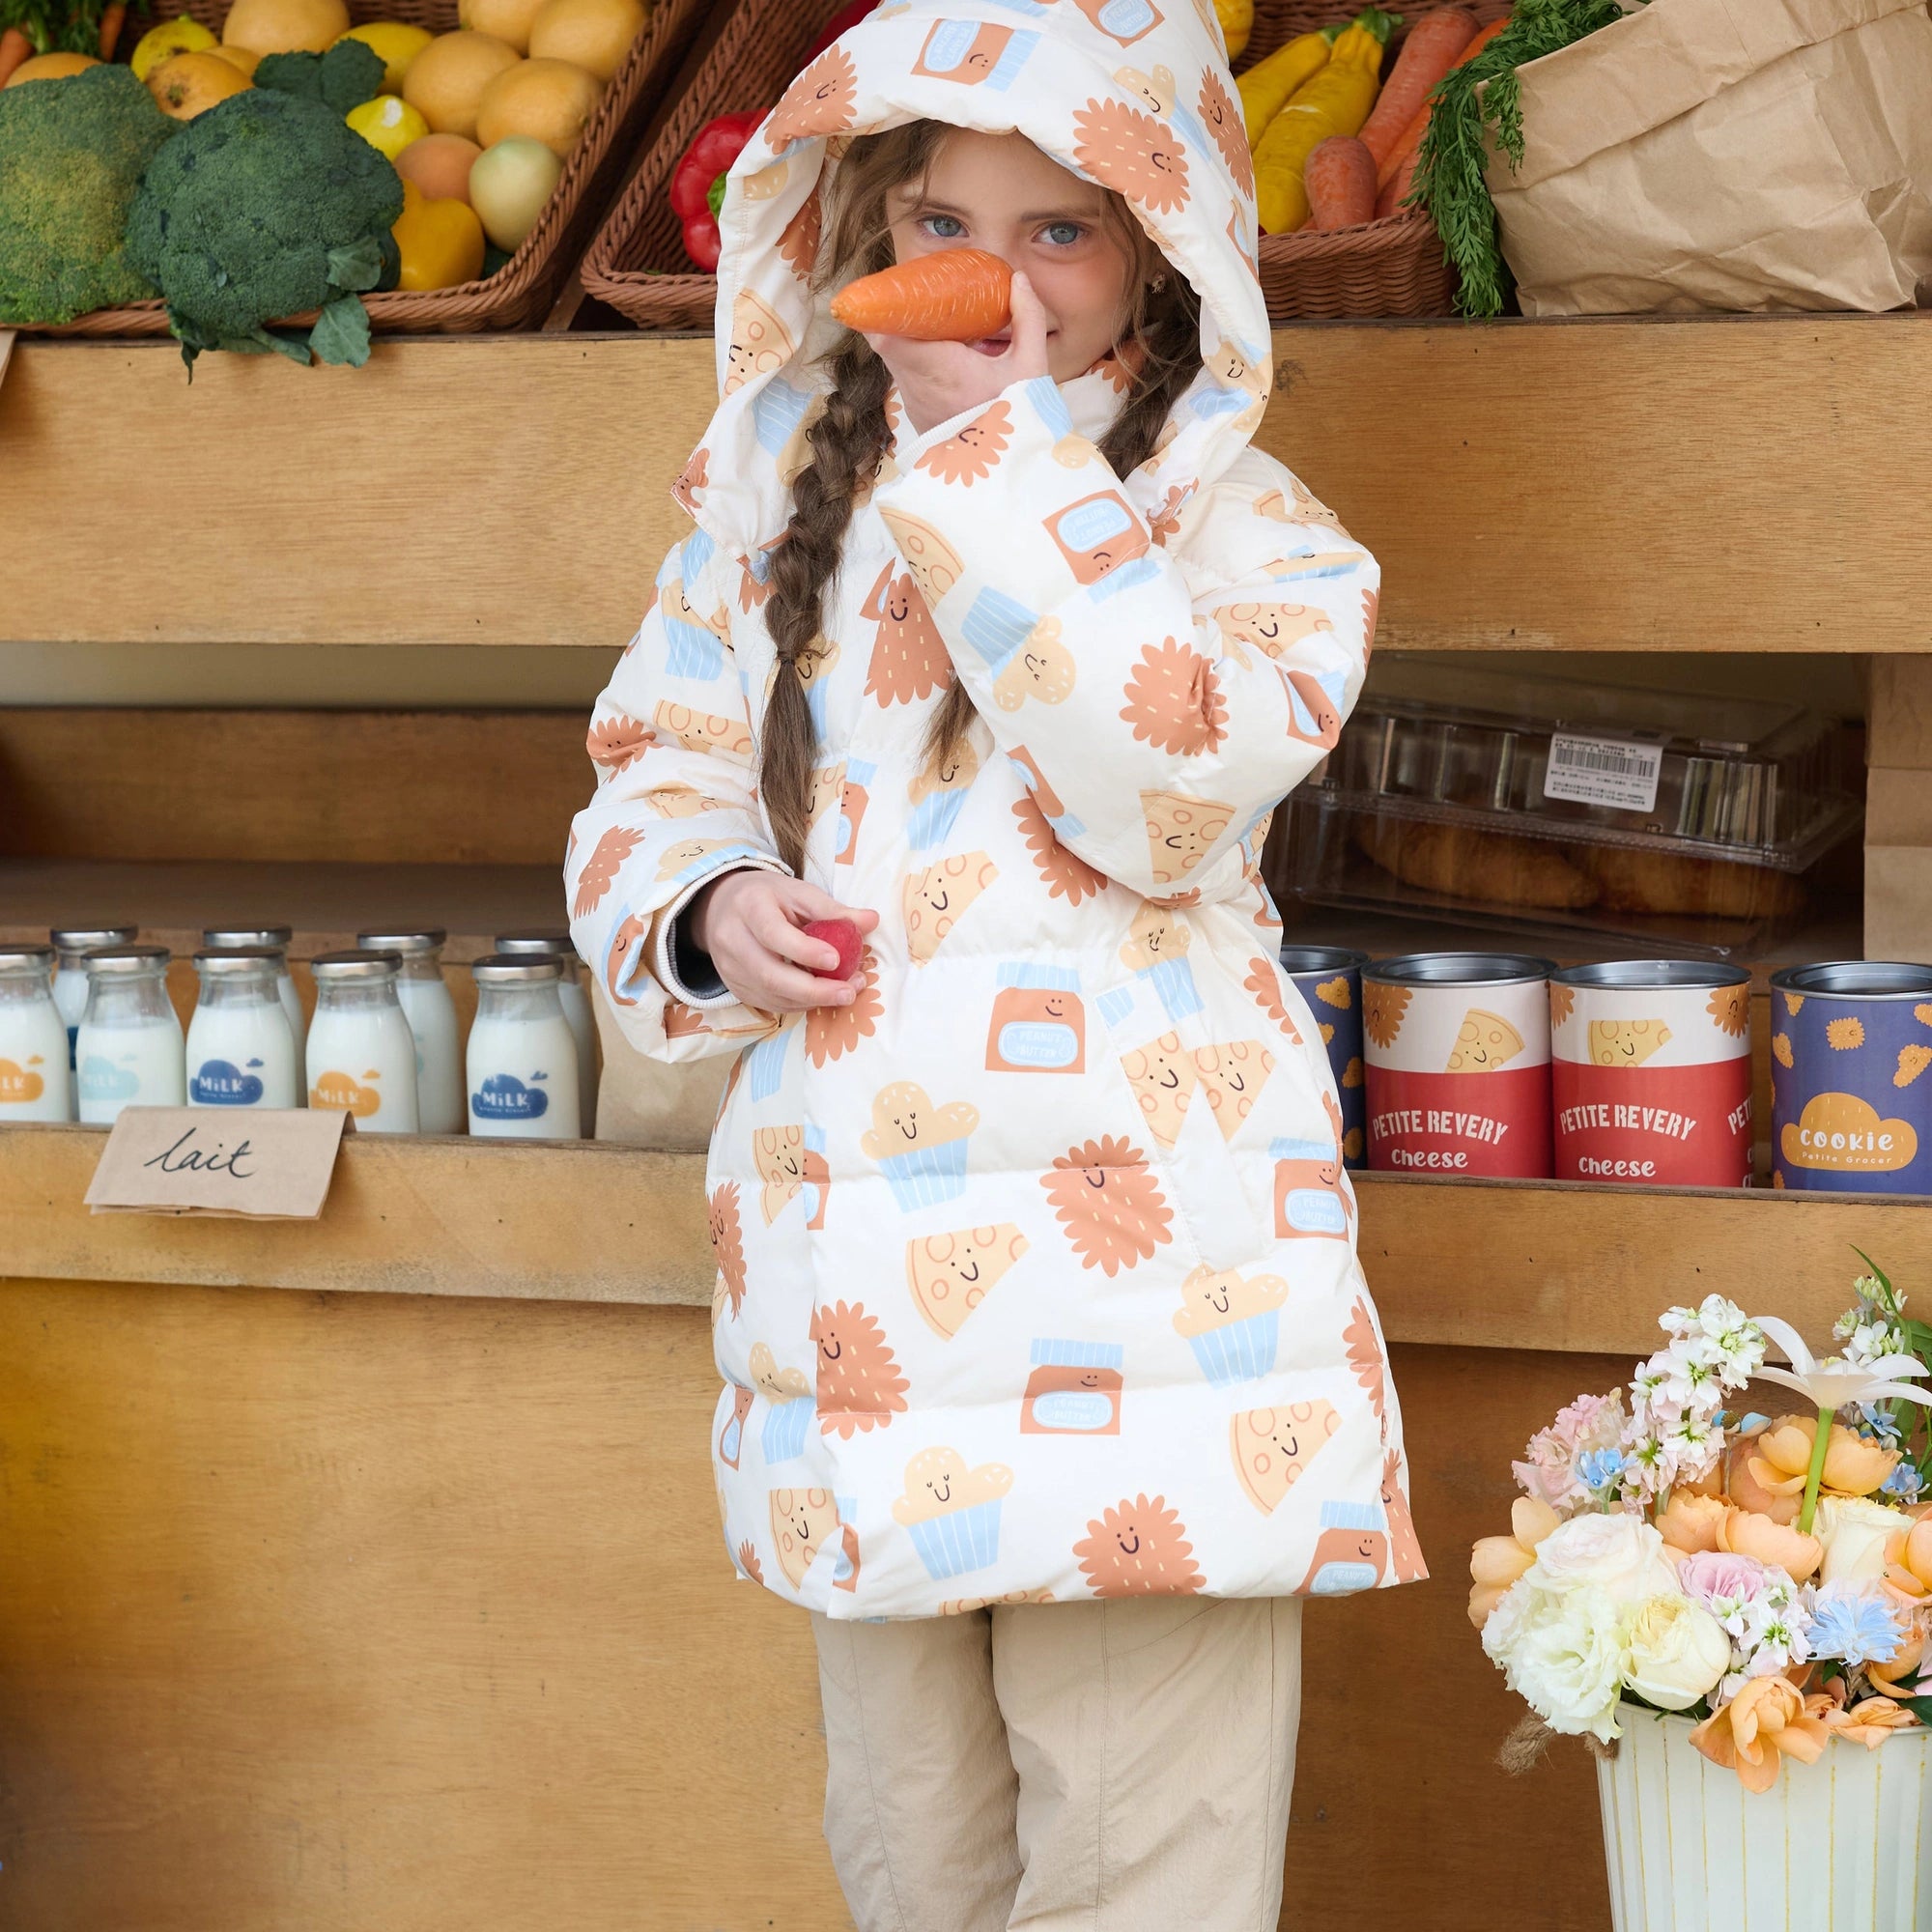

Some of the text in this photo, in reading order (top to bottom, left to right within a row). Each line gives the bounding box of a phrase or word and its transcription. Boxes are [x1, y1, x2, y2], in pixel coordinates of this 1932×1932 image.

[0, 1075, 25, 1091] LK
[482, 1092, 528, 1108] MiLK
[1559, 1103, 1697, 1141] PETITE REVERY
[1727, 1093, 1754, 1136] PETI
[1372, 1109, 1509, 1146] PETITE REVERY
[143, 1126, 257, 1179] lait
[1391, 1148, 1469, 1169] Cheese
[1802, 1151, 1893, 1165] Petite Grocer
[1577, 1155, 1657, 1178] Cheese
